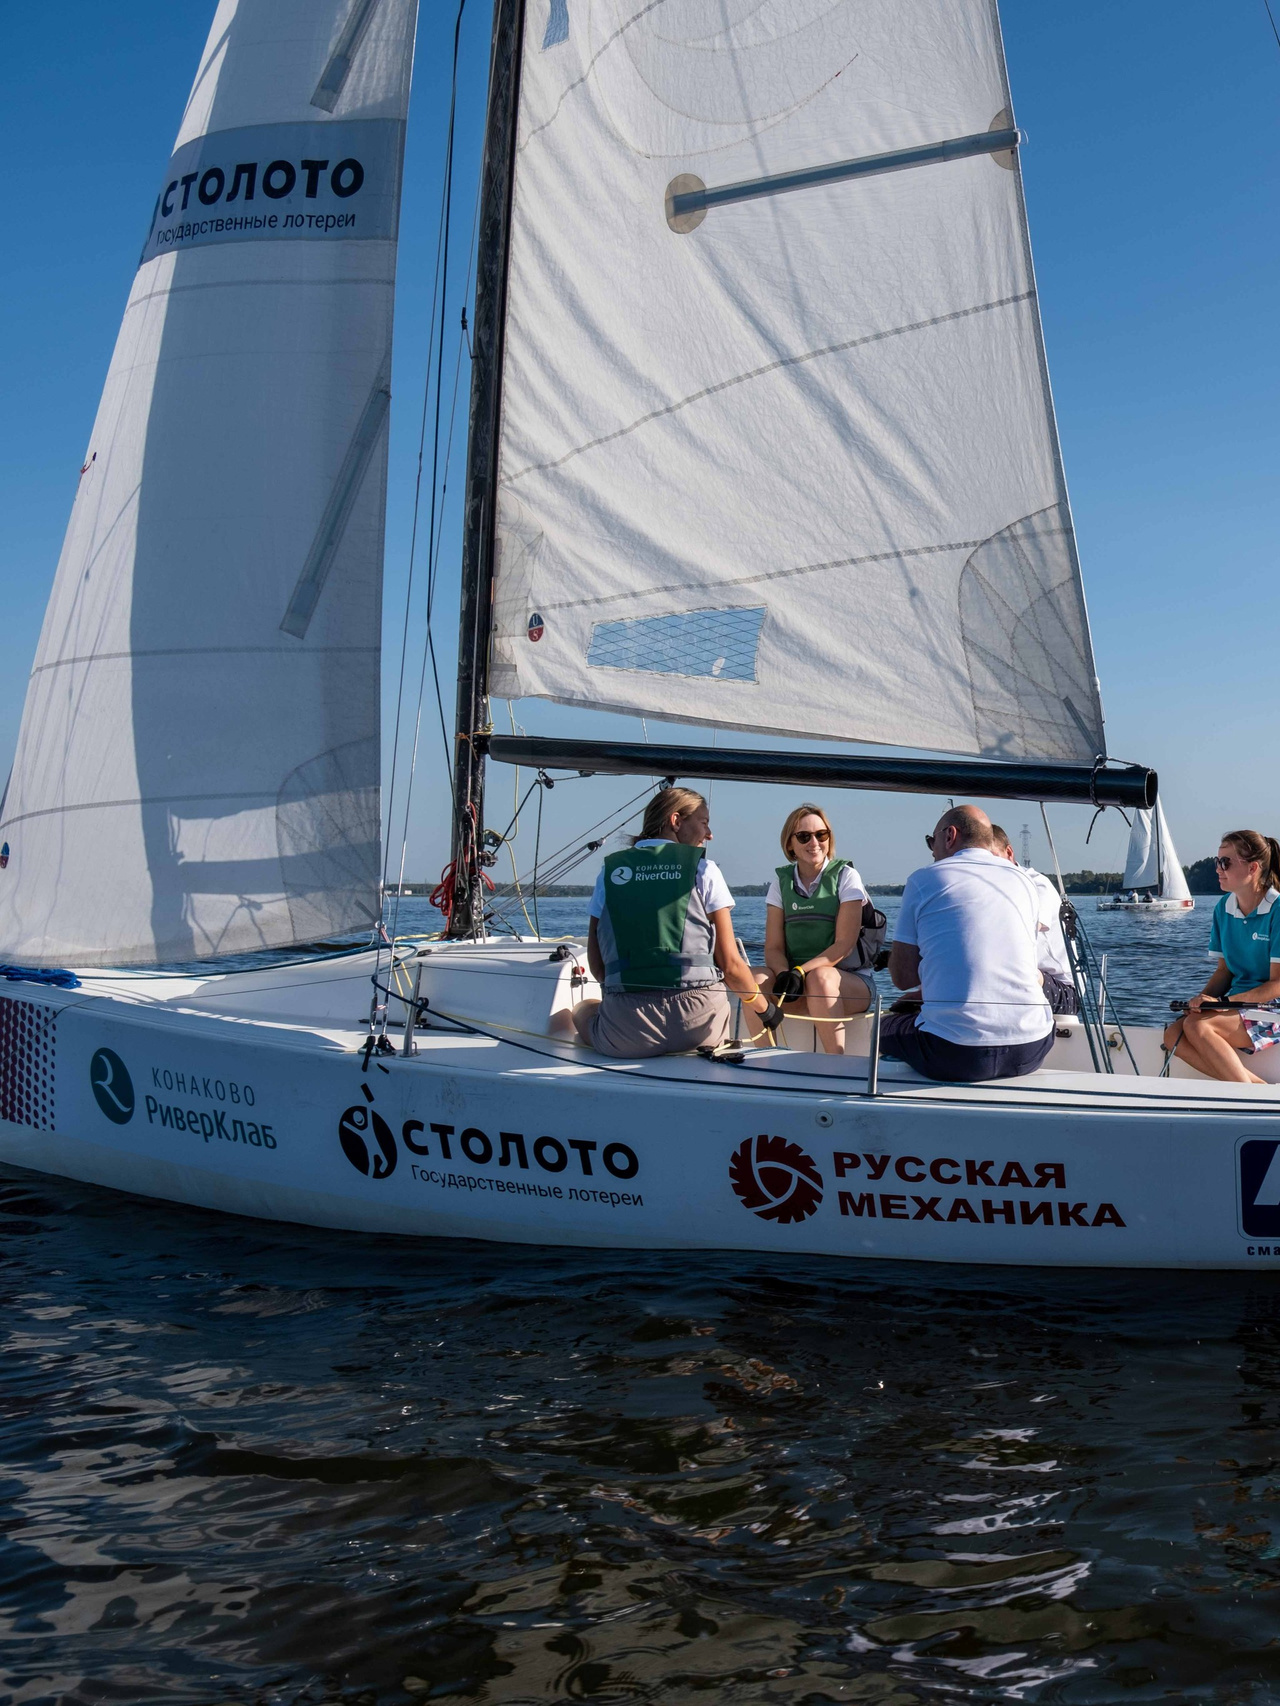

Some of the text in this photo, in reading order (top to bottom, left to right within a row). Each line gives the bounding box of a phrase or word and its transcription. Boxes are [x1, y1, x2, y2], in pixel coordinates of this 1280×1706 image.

[161, 158, 365, 218] СТОЛОТО
[282, 213, 356, 232] лотереи
[635, 871, 682, 881] RiverClub
[151, 1066, 255, 1107] КОНАКОВО
[145, 1094, 277, 1150] РиверКлаб
[402, 1119, 639, 1180] СТОЛОТО
[832, 1151, 1067, 1189] РУССКАЯ
[411, 1164, 644, 1208] Государственные лотереи
[837, 1190, 1127, 1228] МЕХАНИКА
